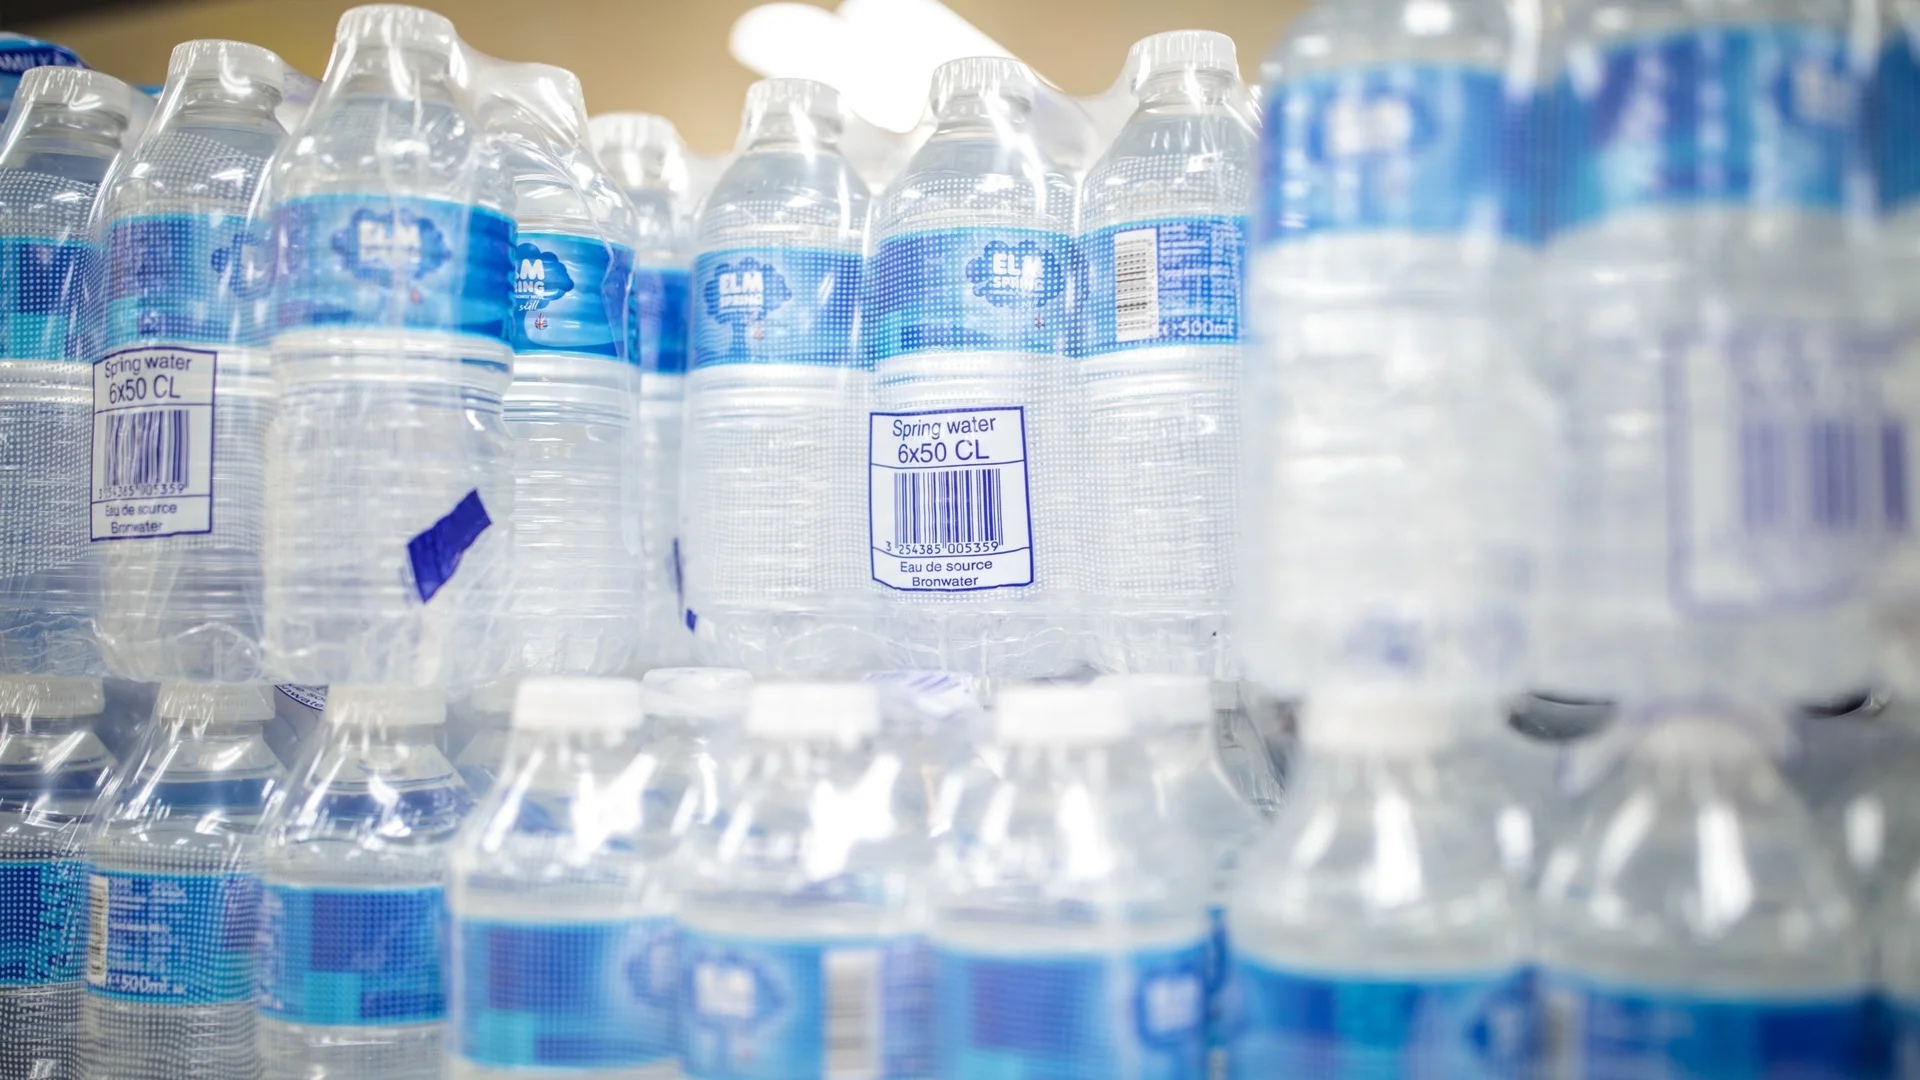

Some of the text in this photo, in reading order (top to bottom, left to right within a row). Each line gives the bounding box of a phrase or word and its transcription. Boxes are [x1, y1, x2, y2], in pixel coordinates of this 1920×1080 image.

[993, 252, 1044, 279] ELM
[718, 270, 764, 295] ELM
[992, 275, 1045, 292] SPRING
[105, 353, 193, 379] Spring water
[109, 374, 181, 404] 6x50 CL
[892, 416, 997, 441] Spring water
[897, 439, 990, 464] 6x50 CL
[121, 504, 135, 516] de
[885, 541, 999, 555] 3 254385 005359
[900, 559, 993, 573] Eau de source
[911, 576, 979, 587] Bronwater
